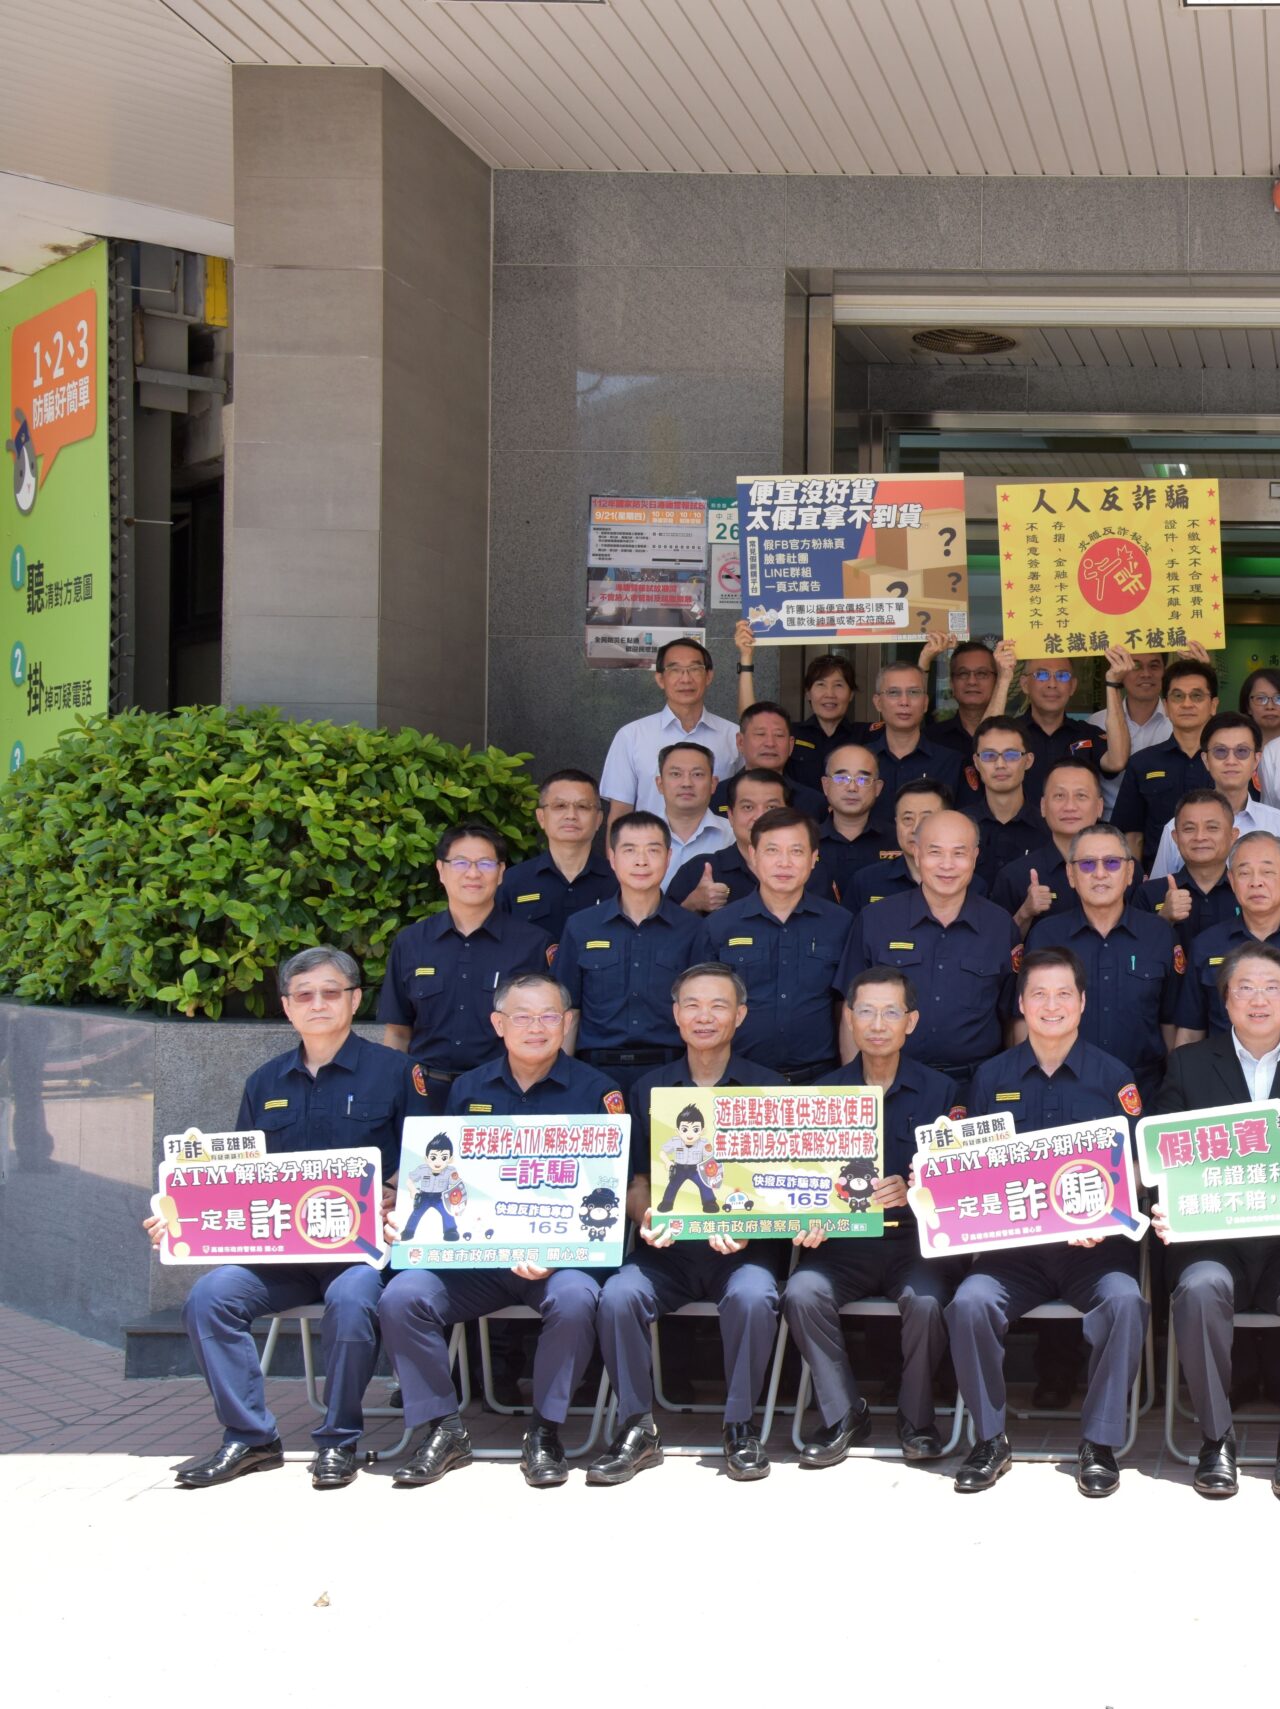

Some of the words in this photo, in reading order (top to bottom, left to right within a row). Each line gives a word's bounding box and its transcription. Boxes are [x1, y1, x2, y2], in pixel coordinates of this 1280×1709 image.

[32, 376, 91, 430] 防騙好簡單
[749, 479, 877, 506] 便宜沒好貨
[1032, 484, 1190, 514] 人人反詐騙
[745, 505, 923, 531] 太便宜拿不到貨
[763, 538, 845, 550] 假FB官方粉絲頁
[763, 553, 809, 564] 臉書社團
[764, 567, 812, 578] LINE群組
[1164, 519, 1182, 621] 證件、手機不離身
[1186, 519, 1203, 620] 不繳交不合理費用
[765, 581, 821, 593] 一頁式廣告
[1025, 523, 1043, 630] 不隨意簽署契約文件
[1052, 521, 1070, 628] 存摺、金融卡不交付
[786, 602, 904, 615] 詐團以極便宜價格引誘下單
[1044, 631, 1110, 654] 能識騙
[1124, 627, 1188, 650] 不被騙
[715, 1096, 876, 1128] 遊戲點數僅供遊戲使用
[715, 1129, 876, 1159] 無法識別身分或解除分期付款
[920, 1129, 954, 1148] 打詐
[961, 1118, 1006, 1137] 高雄隊
[1156, 1117, 1272, 1169] 假投資
[168, 1140, 202, 1159] 打詐
[211, 1136, 256, 1152] 高雄隊
[925, 1152, 982, 1178] ATM
[986, 1127, 1119, 1169] 解除分期付款
[170, 1166, 229, 1187] ATM
[234, 1157, 369, 1185] 解除分期付款
[753, 1174, 832, 1190] 快撥反詐騙專線
[788, 1193, 828, 1206] 165
[934, 1169, 1106, 1222] 一定是詐騙
[177, 1197, 352, 1239] 一定是詐騙
[529, 1222, 568, 1234] 165
[688, 1219, 800, 1234] 高雄市政府警察局
[427, 1248, 539, 1262] 高雄市政府警察局
